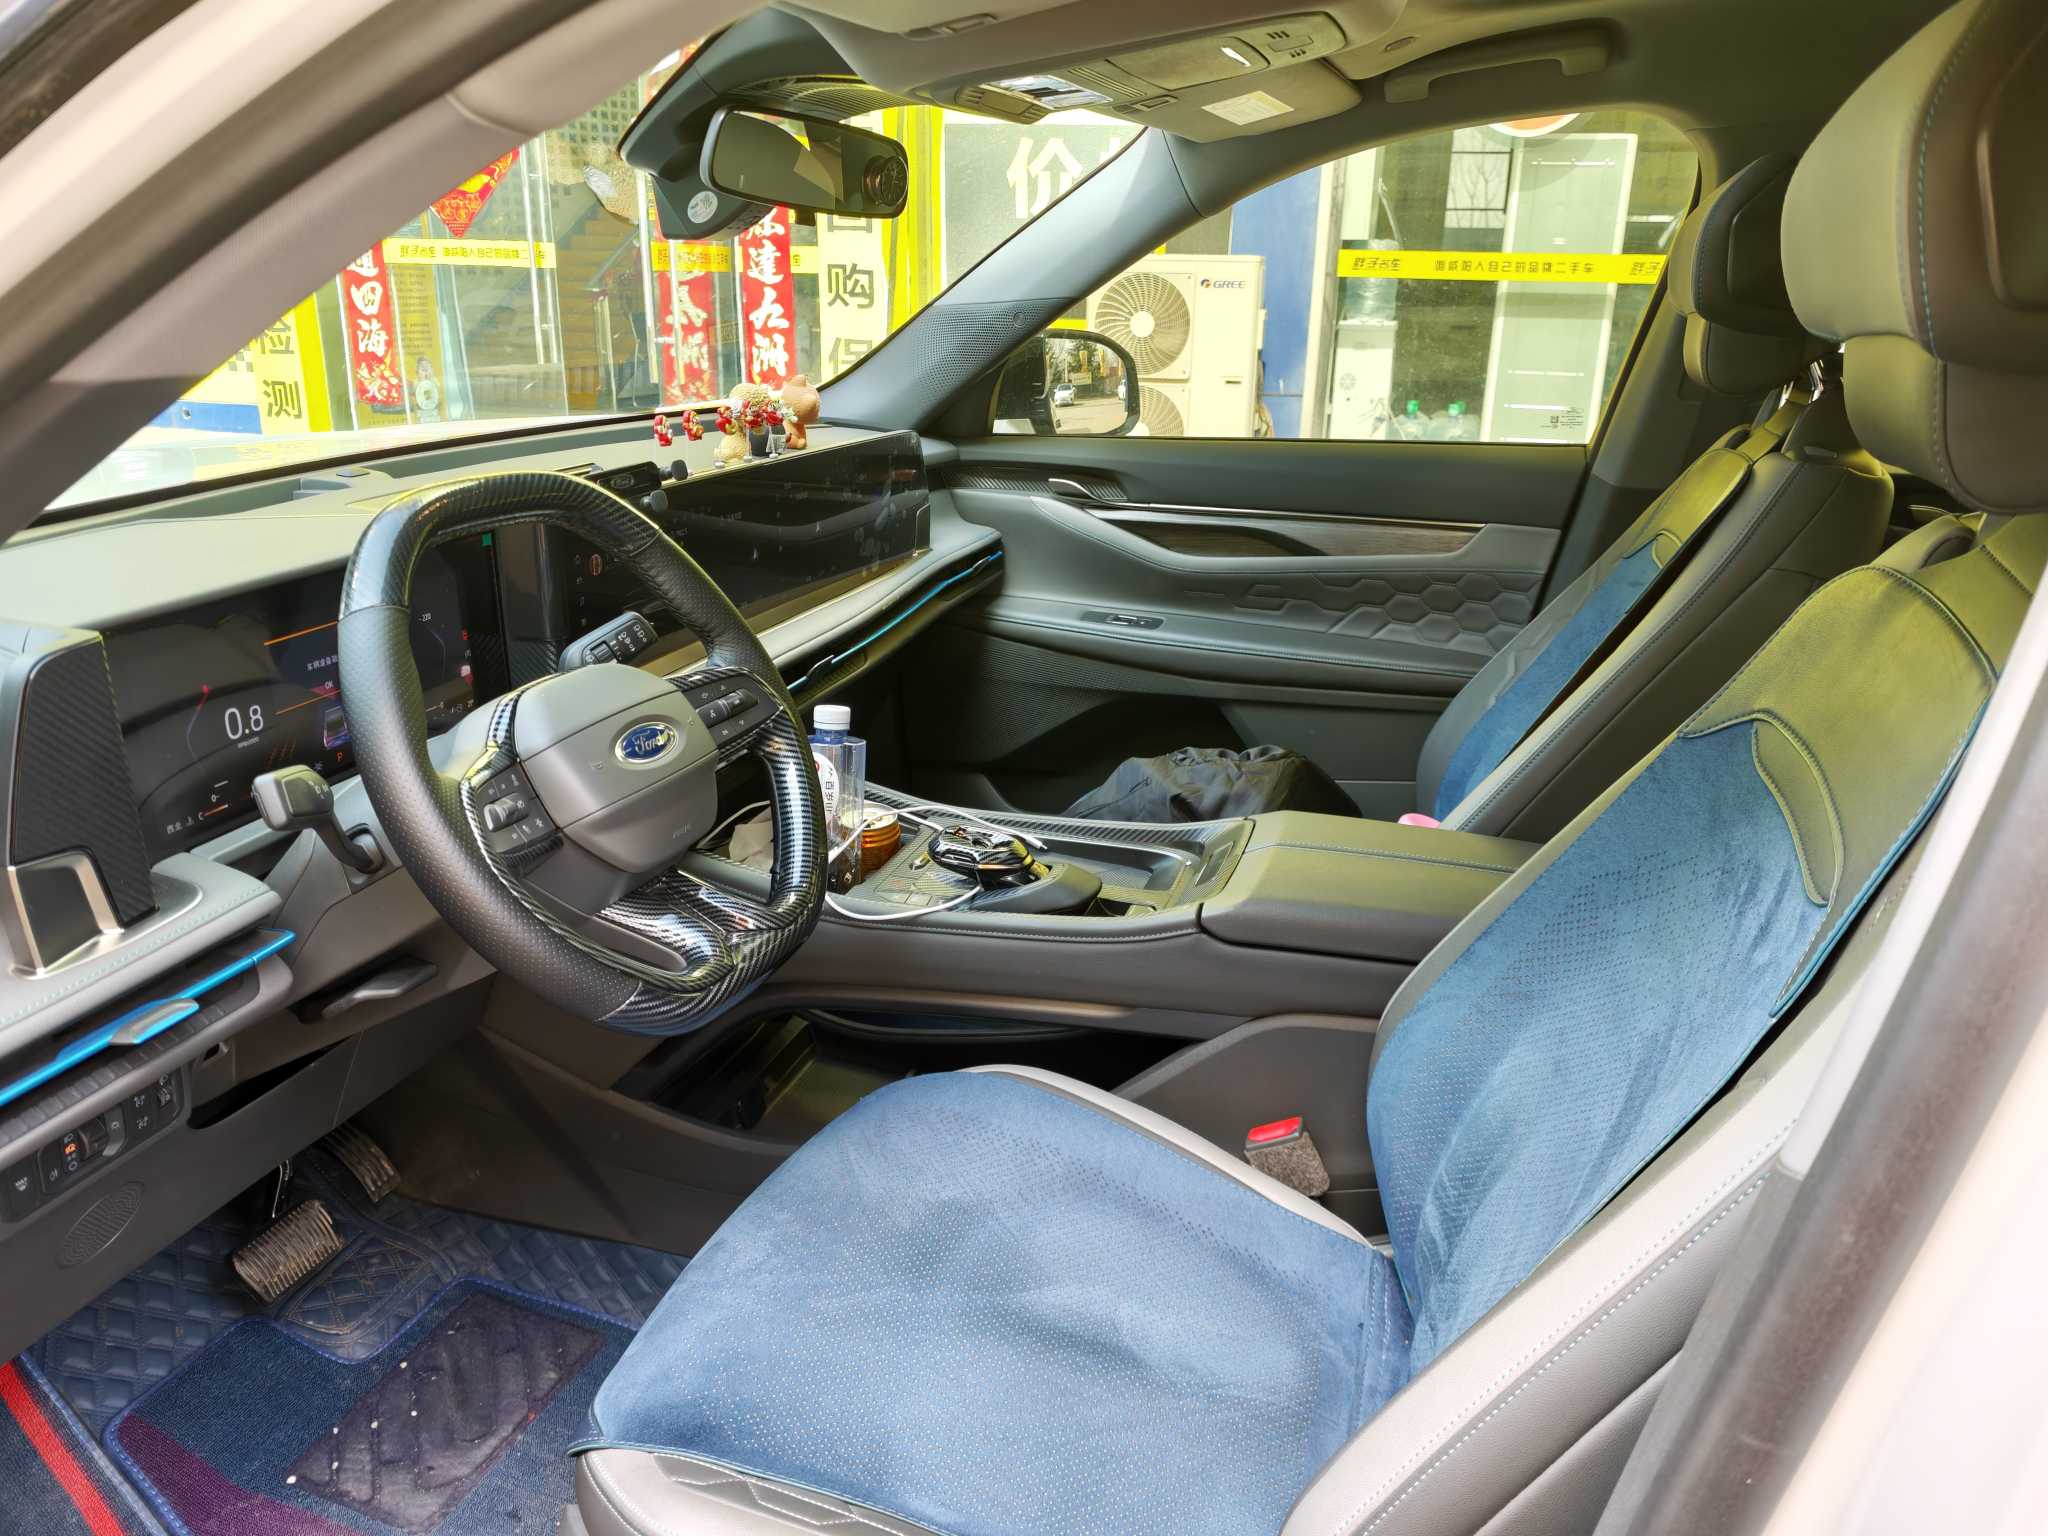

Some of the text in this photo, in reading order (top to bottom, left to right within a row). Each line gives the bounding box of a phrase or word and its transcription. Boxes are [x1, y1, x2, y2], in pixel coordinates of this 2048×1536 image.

[1213, 280, 1248, 289] GREE
[225, 705, 264, 739] 0.8
[632, 728, 673, 755] Ford
